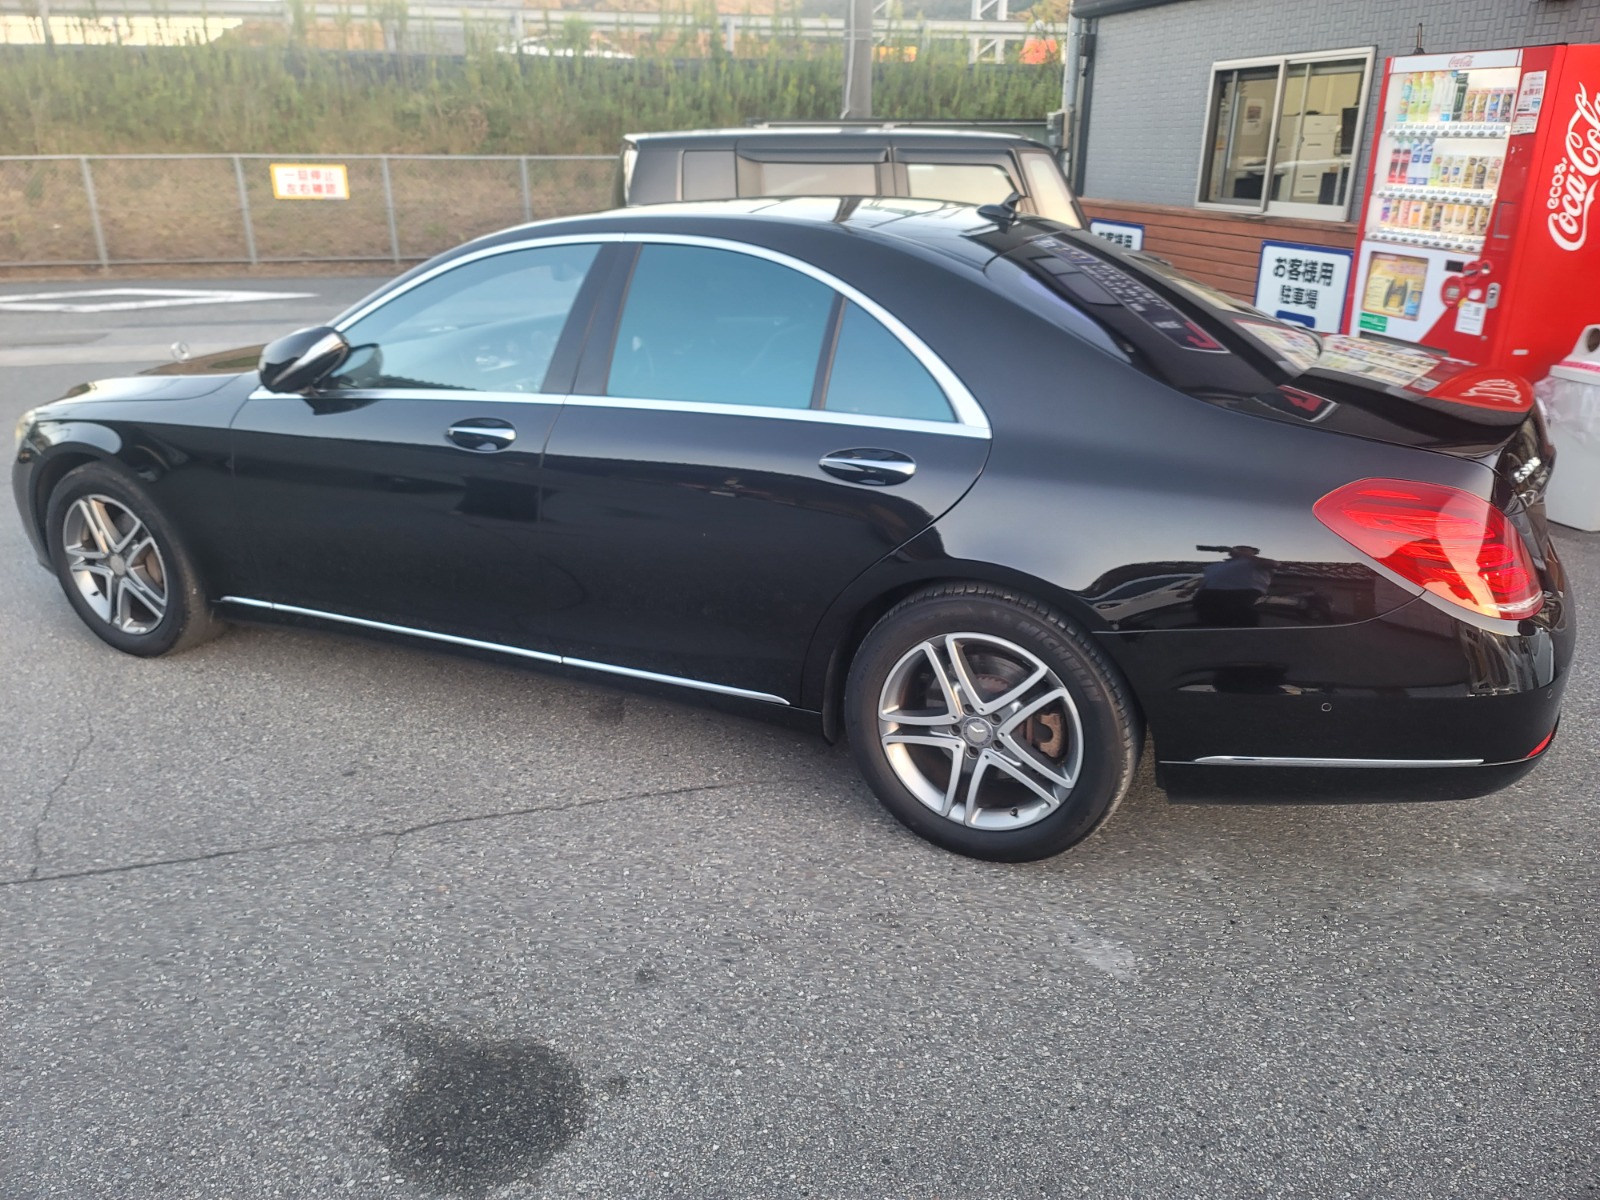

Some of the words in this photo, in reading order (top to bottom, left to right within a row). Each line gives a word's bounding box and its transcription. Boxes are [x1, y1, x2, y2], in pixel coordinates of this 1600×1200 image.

[1273, 256, 1335, 287] お客様用
[1279, 284, 1319, 310] 駐車場
